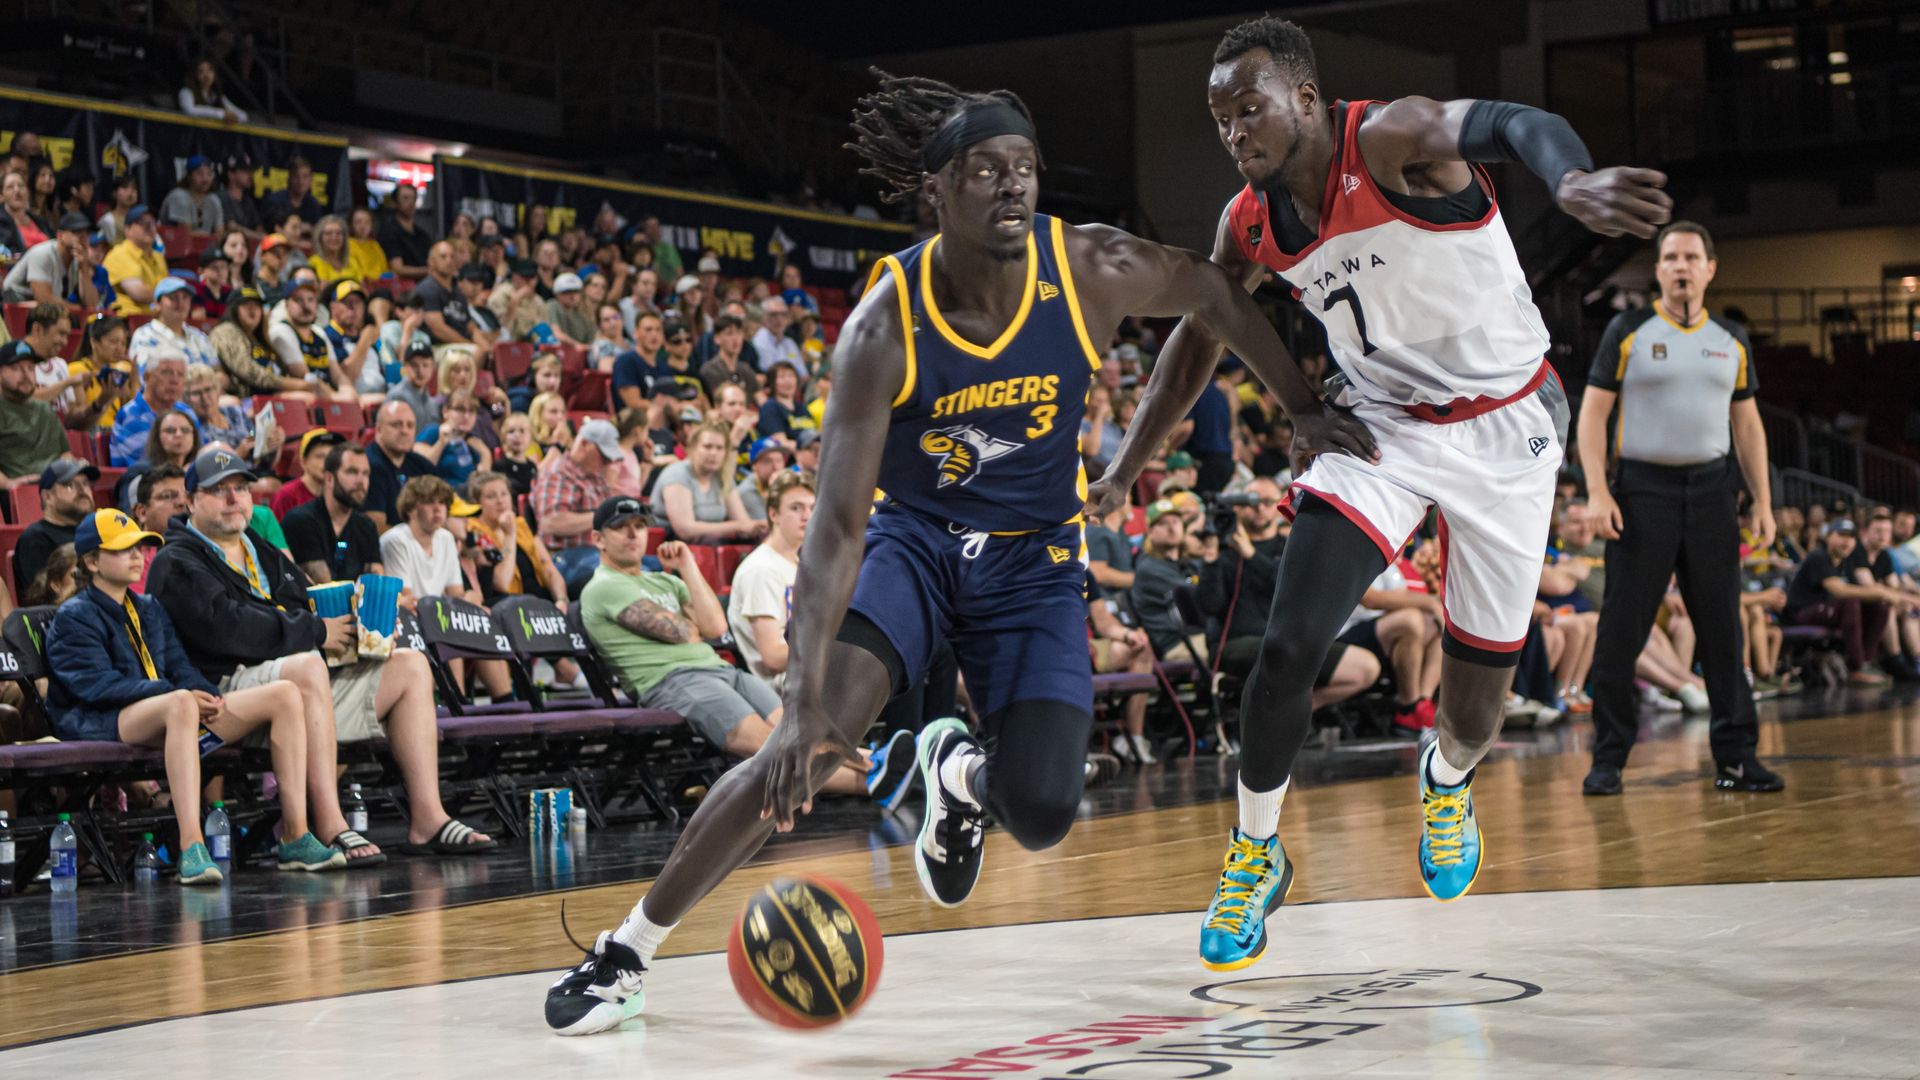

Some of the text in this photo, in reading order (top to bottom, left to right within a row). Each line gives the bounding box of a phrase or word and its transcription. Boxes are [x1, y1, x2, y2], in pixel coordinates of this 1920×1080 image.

[1323, 282, 1379, 357] 7
[931, 374, 1060, 418] STINGERS
[1025, 404, 1059, 439] 3
[451, 611, 491, 635] HUFF
[530, 616, 567, 635] HUFF
[407, 633, 426, 651] 20
[495, 635, 511, 651] 21
[569, 633, 586, 649] 22
[1262, 969, 1461, 1014] NISSAN
[1040, 1019, 1386, 1080] ERIC
